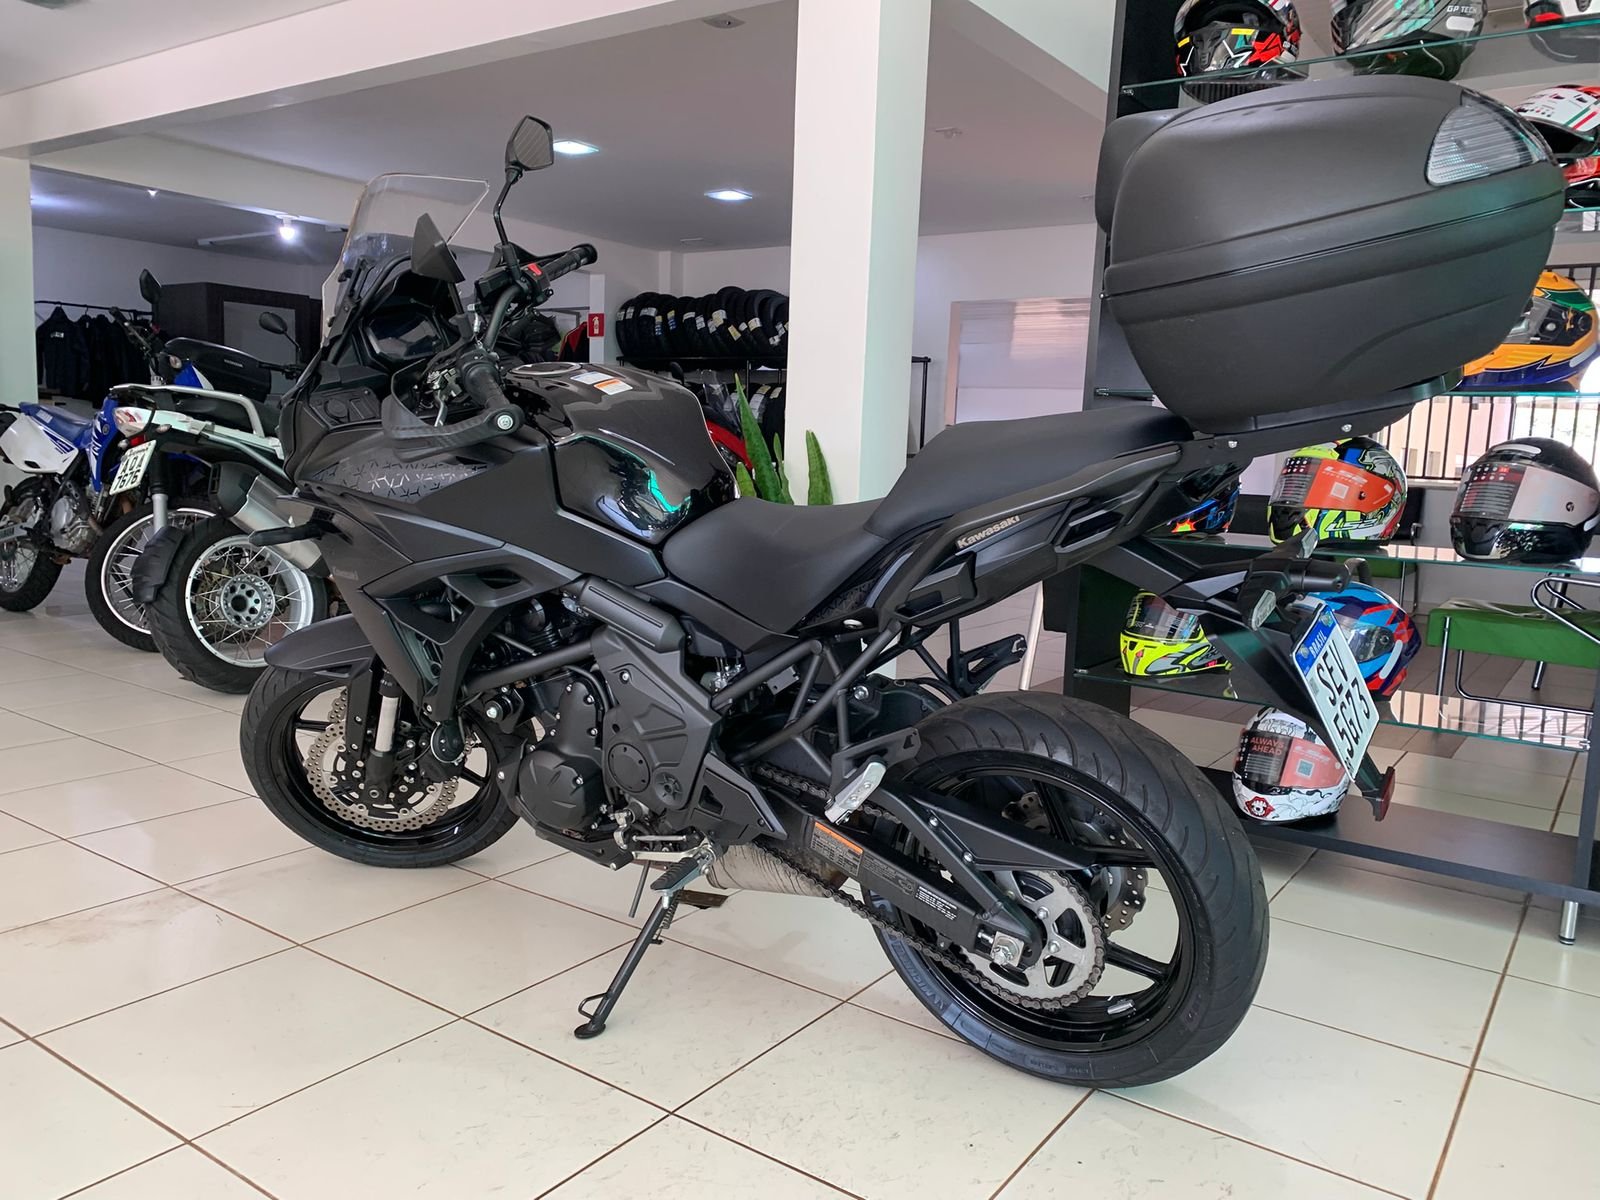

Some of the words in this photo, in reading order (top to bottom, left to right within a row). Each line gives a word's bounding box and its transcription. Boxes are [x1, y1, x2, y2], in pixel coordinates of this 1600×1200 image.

[1446, 5, 1460, 13] GP
[957, 515, 1020, 549] Kawasaki
[1325, 519, 1378, 532] LS2
[1308, 630, 1328, 660] BRASIL
[1316, 639, 1348, 707] SEV
[1332, 677, 1371, 759] 5G73
[1249, 736, 1285, 750] ALWAYS
[1251, 744, 1283, 756] AHEAD
